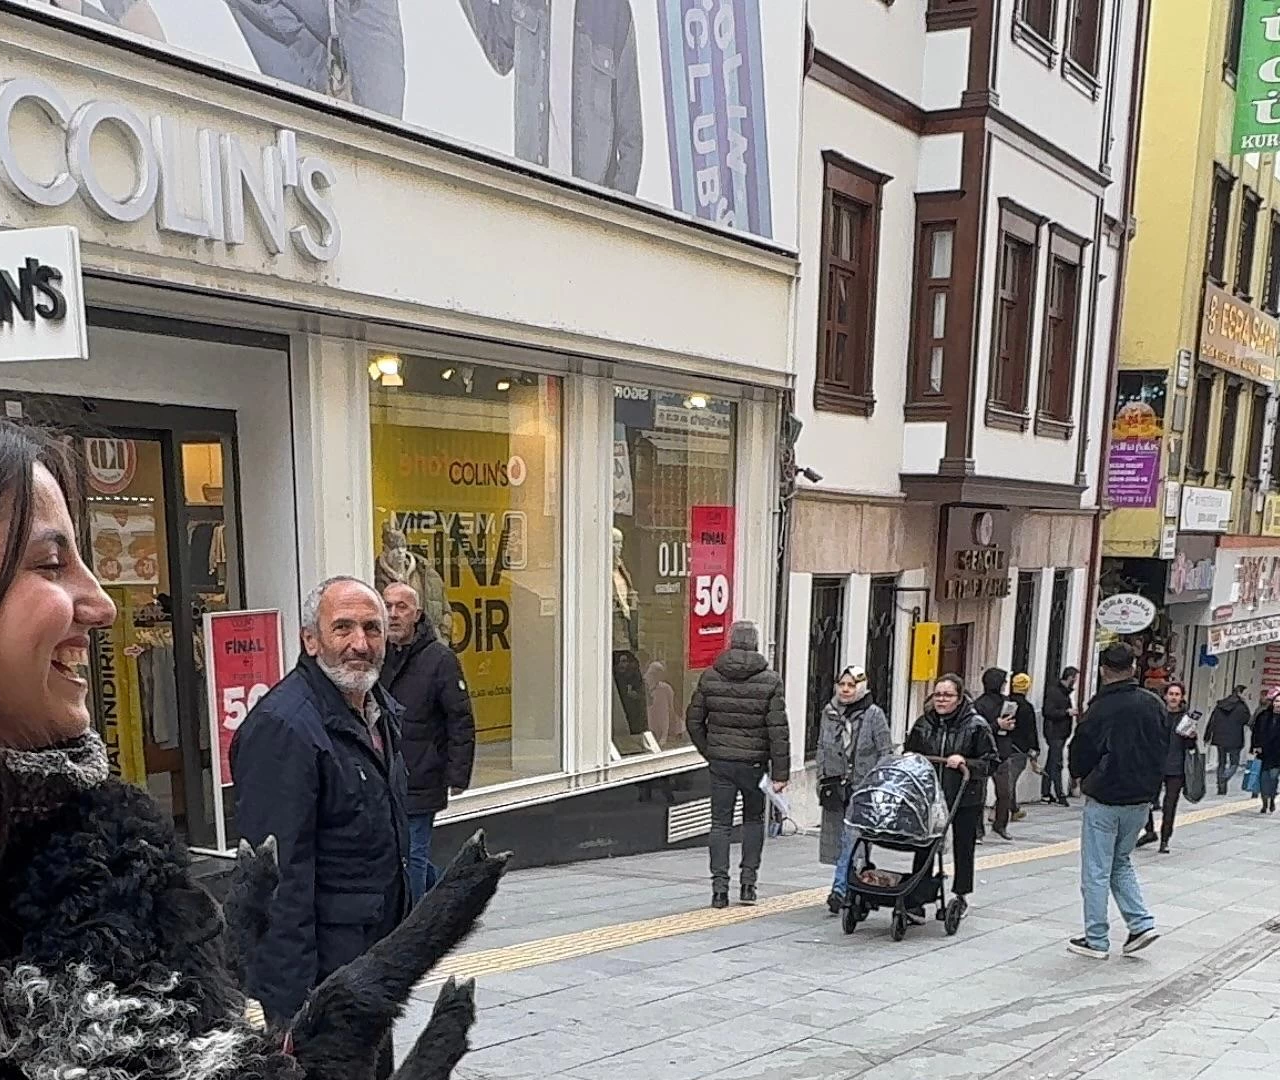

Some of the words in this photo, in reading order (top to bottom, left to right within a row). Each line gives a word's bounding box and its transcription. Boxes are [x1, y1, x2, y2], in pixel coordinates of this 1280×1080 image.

[684, 8, 722, 208] CLUB
[449, 460, 510, 487] COLIN'S
[694, 574, 730, 617] 50
